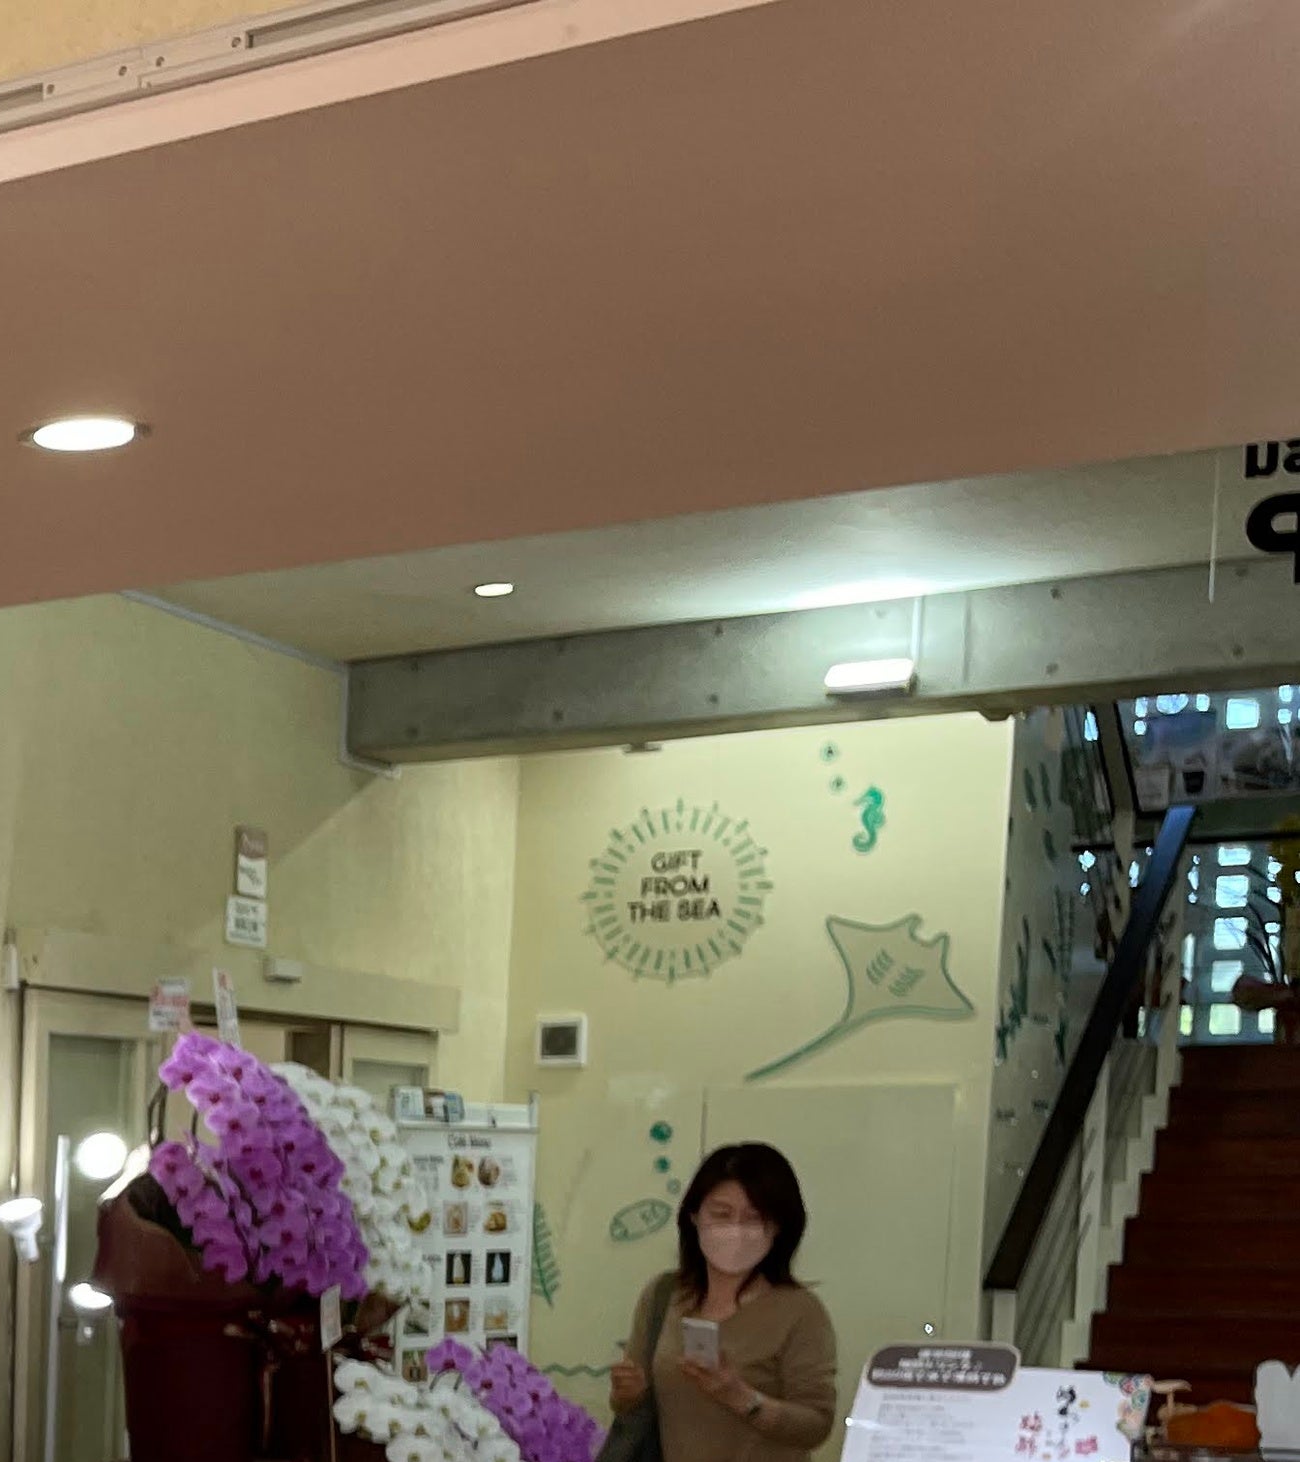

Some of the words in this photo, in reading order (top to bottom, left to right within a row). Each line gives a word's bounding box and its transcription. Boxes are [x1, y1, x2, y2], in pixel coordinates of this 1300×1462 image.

[650, 849, 703, 873] GIFT
[640, 874, 710, 898] FROM
[627, 900, 671, 923] THE
[676, 898, 721, 922] SEA
